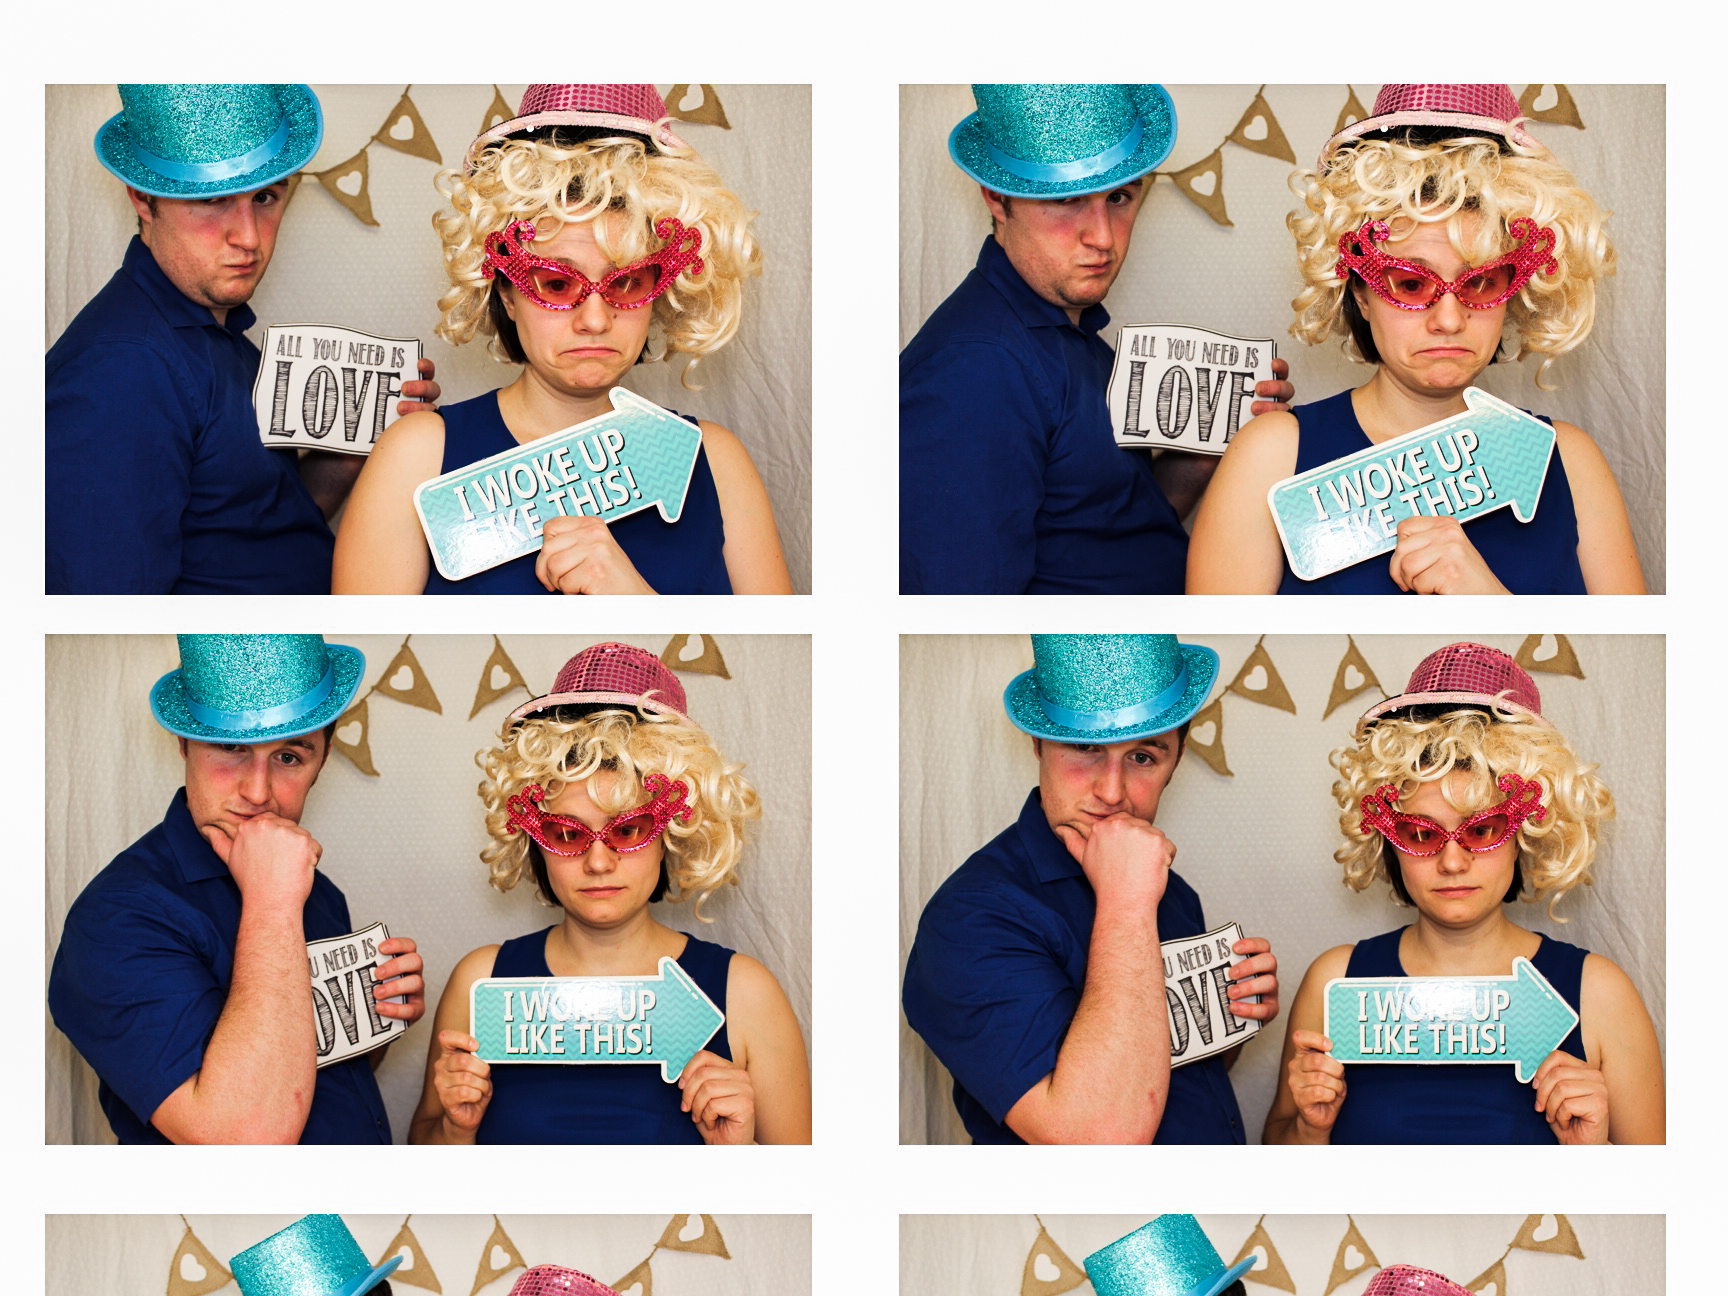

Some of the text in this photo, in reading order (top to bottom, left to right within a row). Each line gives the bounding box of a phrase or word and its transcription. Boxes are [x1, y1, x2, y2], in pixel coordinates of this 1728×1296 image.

[276, 334, 405, 368] ALL YOU NEED IS
[1130, 334, 1259, 368] ALL YOU NEED IS
[269, 360, 401, 443] LOVE
[1123, 360, 1255, 443] LOVE
[453, 428, 625, 522] I WOKE UP
[546, 465, 643, 517] THIS!
[1307, 428, 1479, 522] I WOKE UP
[1400, 465, 1497, 517] THIS!
[323, 943, 359, 974] NEED
[362, 937, 377, 960] IS
[1177, 943, 1213, 974] NEED
[1216, 937, 1231, 960] IS
[312, 961, 393, 1057] OVE
[504, 991, 514, 1022] I
[617, 989, 657, 1022] UP
[1166, 961, 1247, 1057] OVE
[1358, 991, 1368, 1022] I
[1471, 989, 1511, 1022] UP
[505, 1023, 653, 1055] LIKE THIS!
[1359, 1023, 1507, 1055] LIKE THIS!
